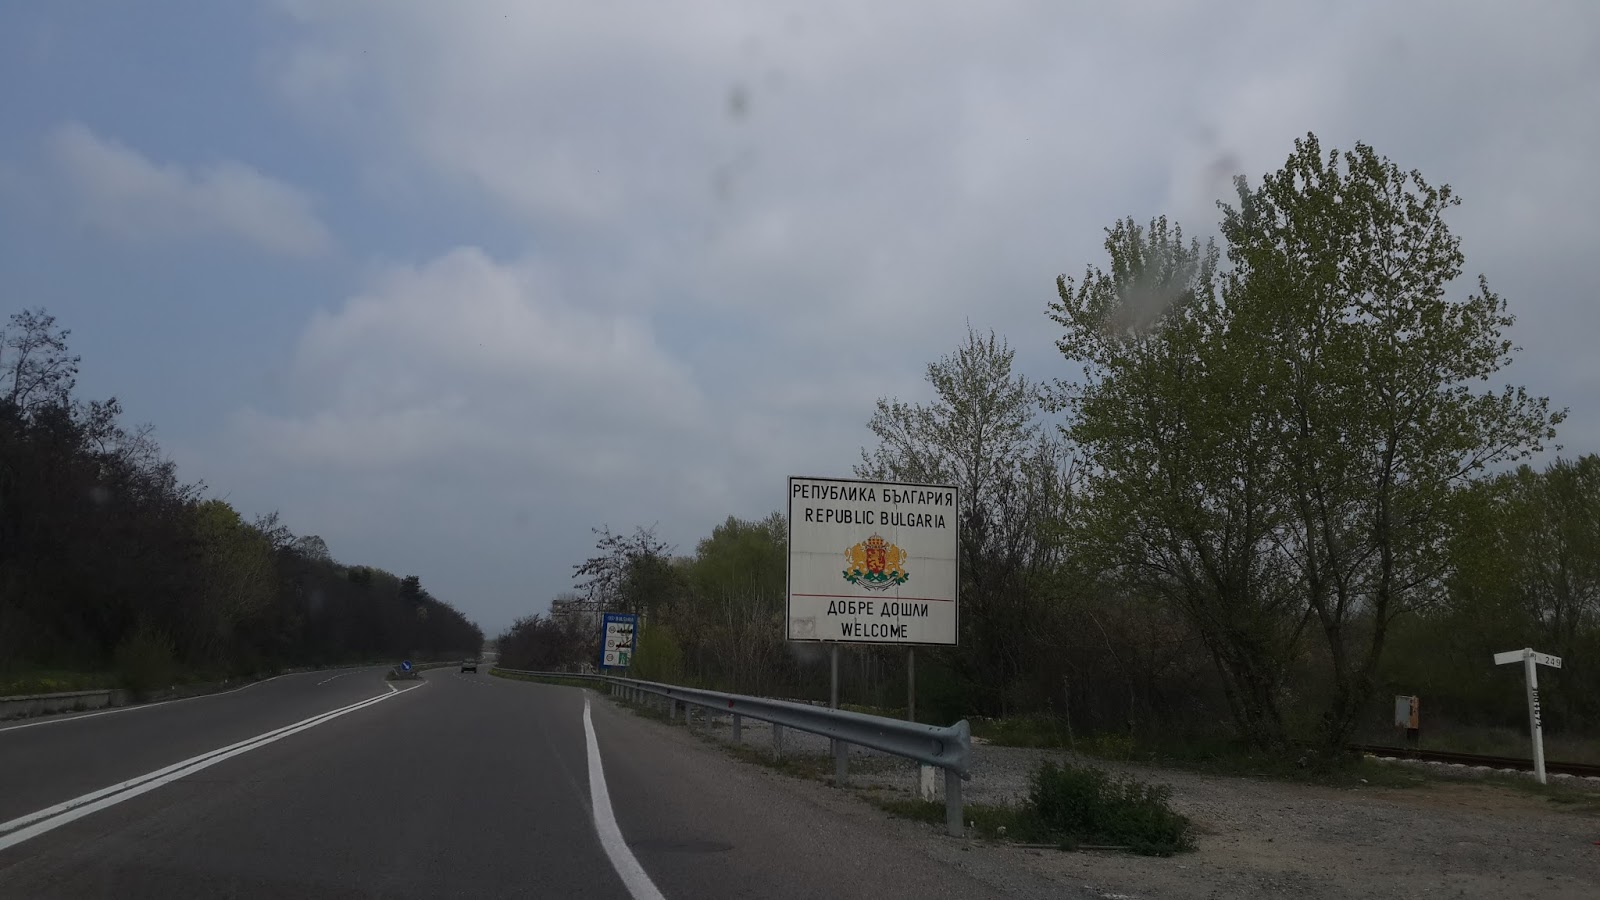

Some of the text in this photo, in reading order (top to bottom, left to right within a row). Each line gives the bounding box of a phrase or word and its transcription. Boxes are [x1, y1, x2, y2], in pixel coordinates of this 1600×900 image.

[793, 484, 953, 507] РЕПУБЛИКА БЪЛГАРИЯ
[805, 508, 946, 529] REPUBLIC BULGARIA
[827, 601, 928, 618] ДОБРЕ ДОШЛИ
[841, 622, 908, 638] WELCOME
[1545, 656, 1560, 666] 249
